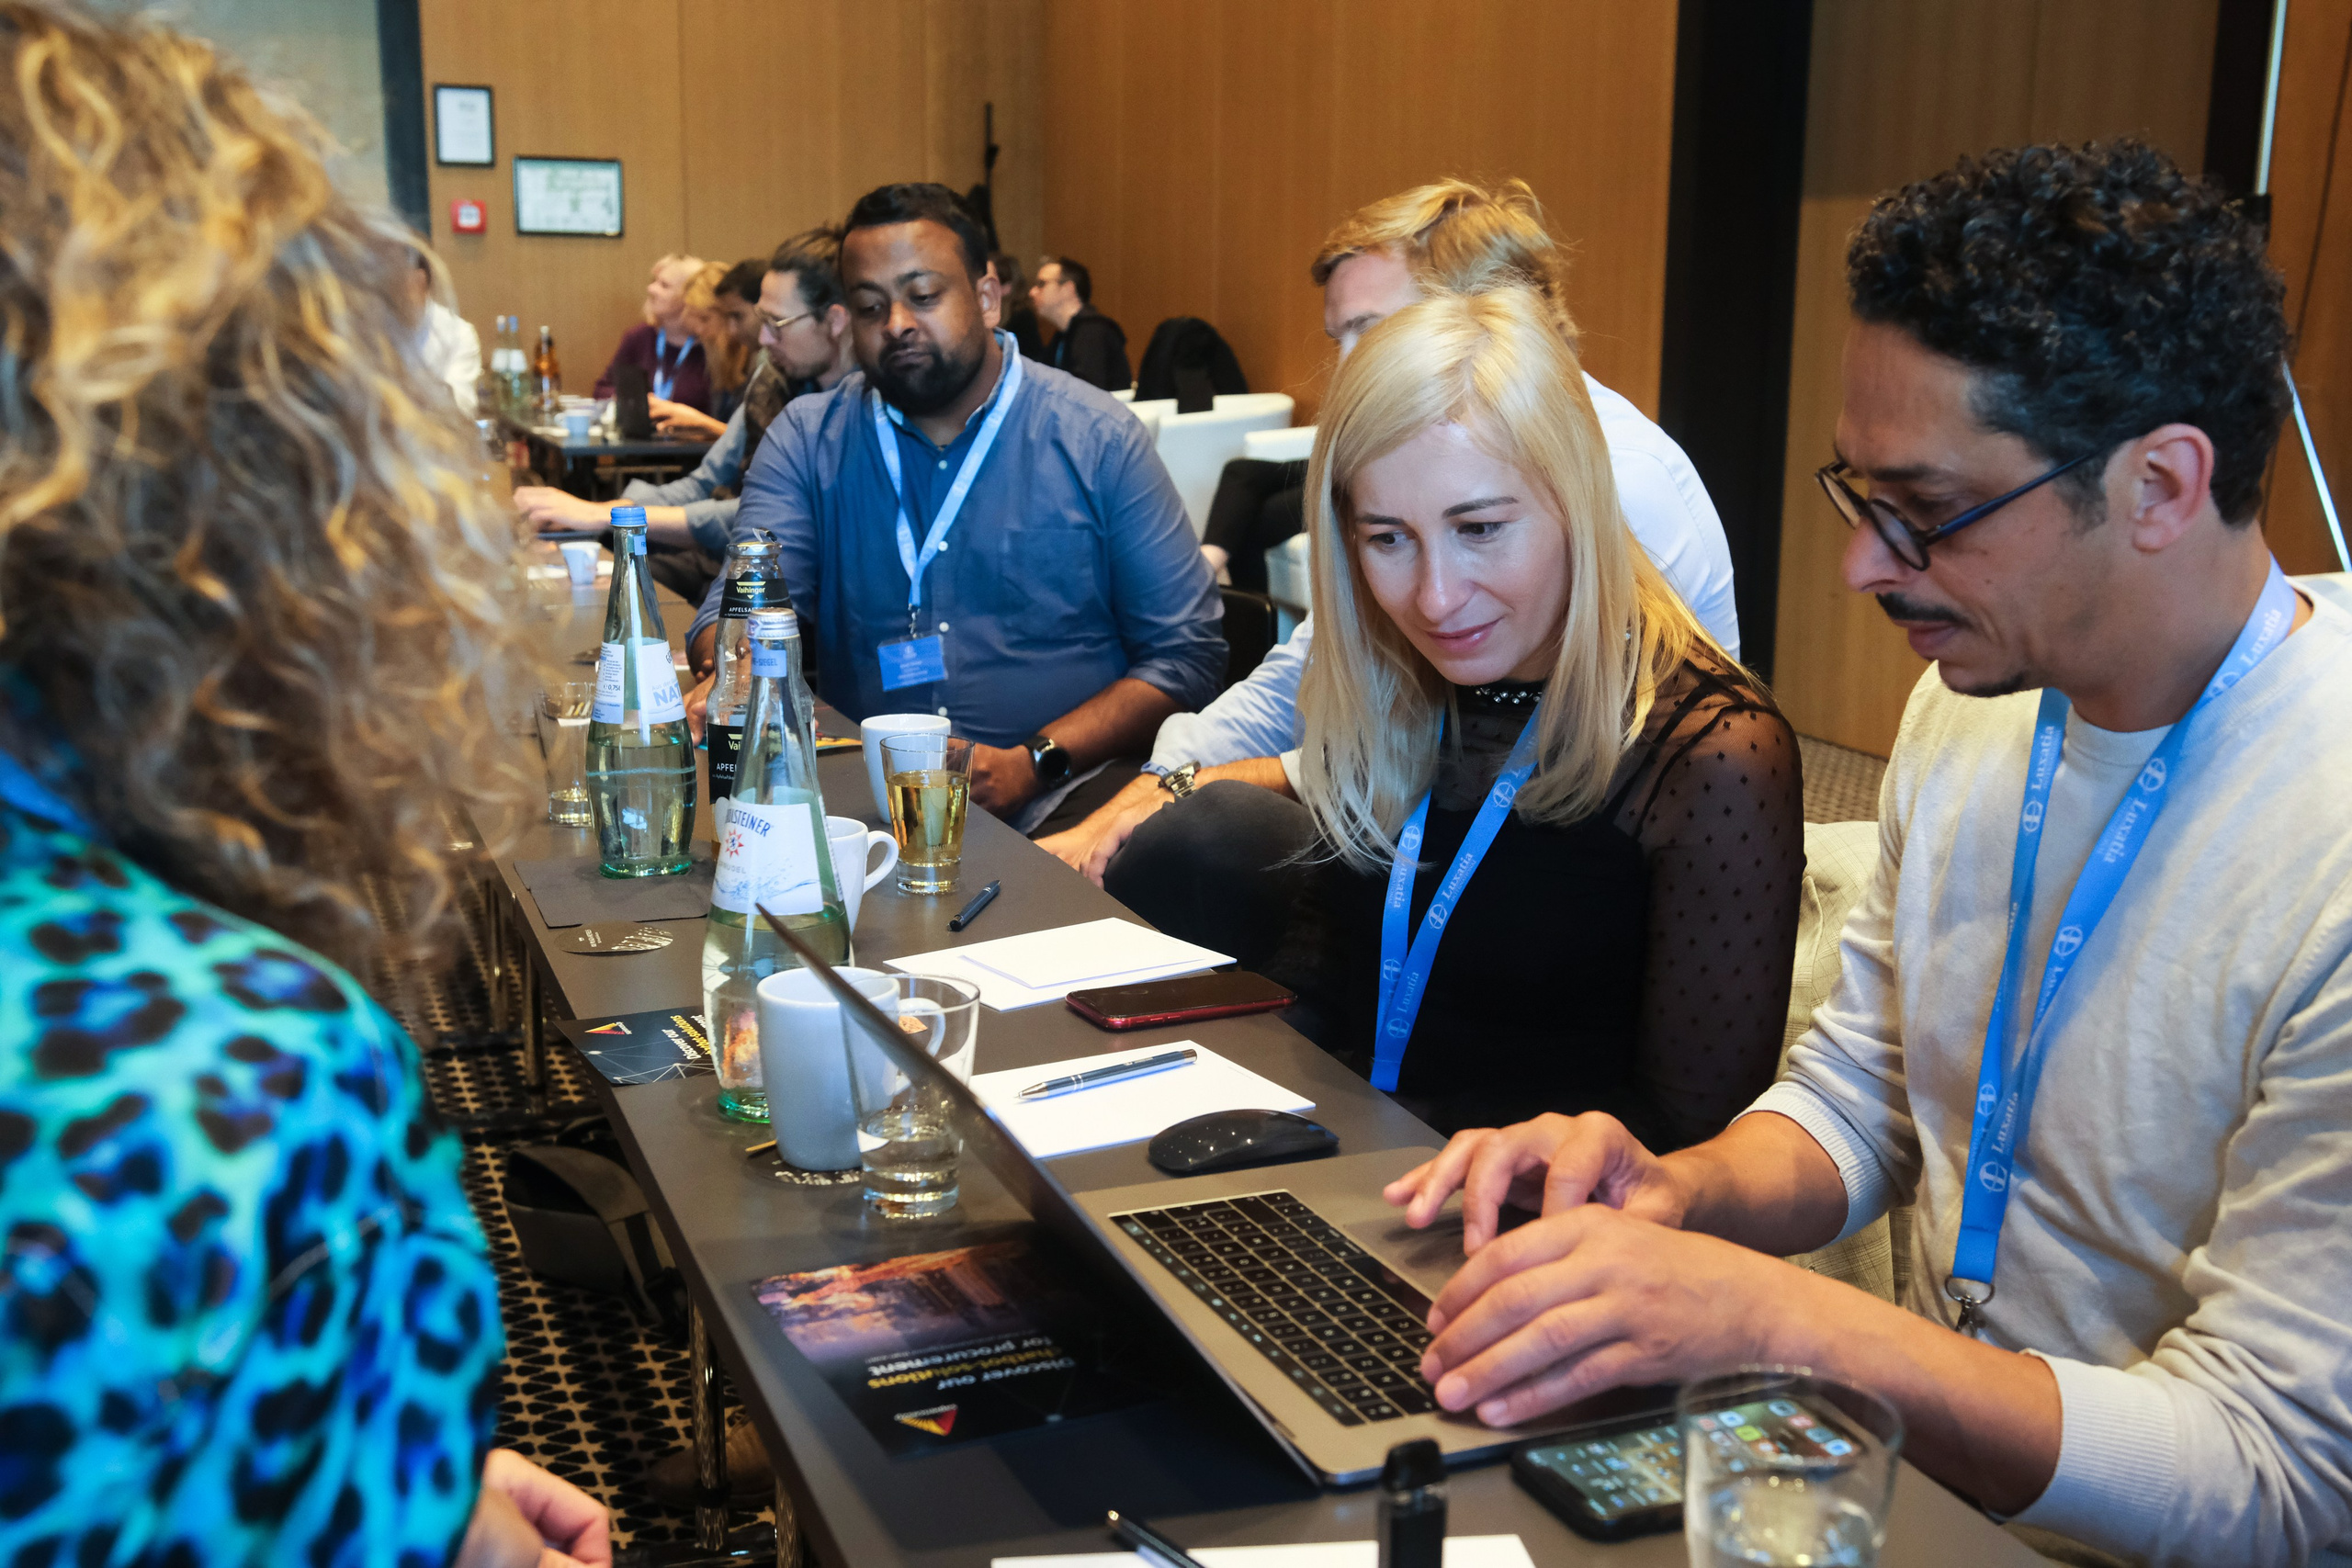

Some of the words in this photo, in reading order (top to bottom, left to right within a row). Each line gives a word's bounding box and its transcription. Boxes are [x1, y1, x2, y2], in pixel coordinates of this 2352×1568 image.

[736, 586, 765, 594] Vaihinger
[2241, 608, 2282, 668] Luxatia
[653, 682, 682, 706] NAT
[2030, 725, 2055, 792] Luxatia
[2104, 797, 2148, 864] Luxatia
[1392, 863, 1409, 908] uxatia
[1445, 852, 1475, 901] Luxatia
[1396, 971, 1420, 1014] Luxatia
[1992, 1091, 2019, 1155] Luxatia
[867, 1340, 1016, 1377] procurement
[981, 1356, 1076, 1382] Discover
[937, 1374, 977, 1391] our
